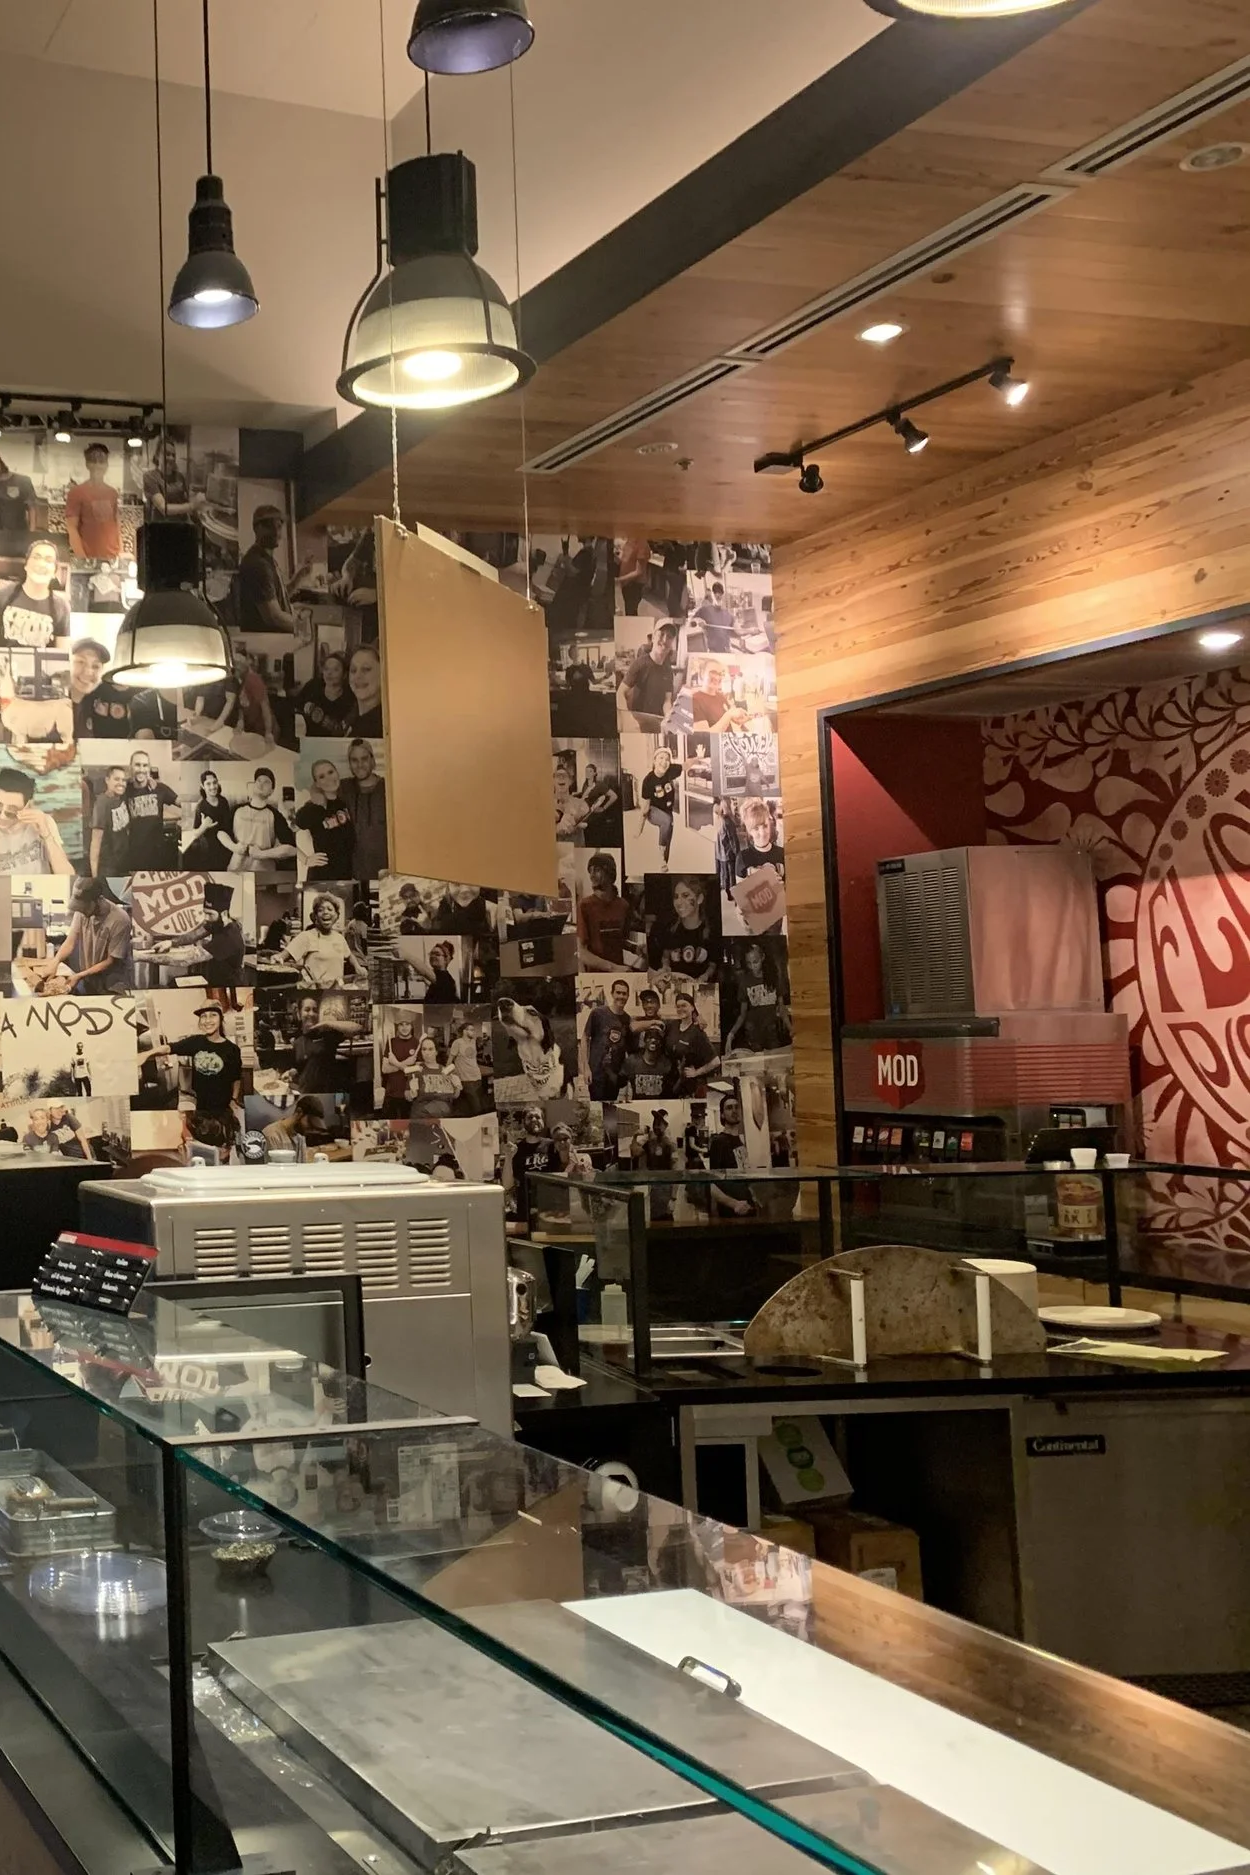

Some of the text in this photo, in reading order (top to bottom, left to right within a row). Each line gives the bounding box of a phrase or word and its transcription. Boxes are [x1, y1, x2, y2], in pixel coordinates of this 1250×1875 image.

[133, 874, 207, 924] MOD
[171, 909, 199, 933] LOVE
[26, 1000, 114, 1037] MOD
[877, 1054, 919, 1087] MOD
